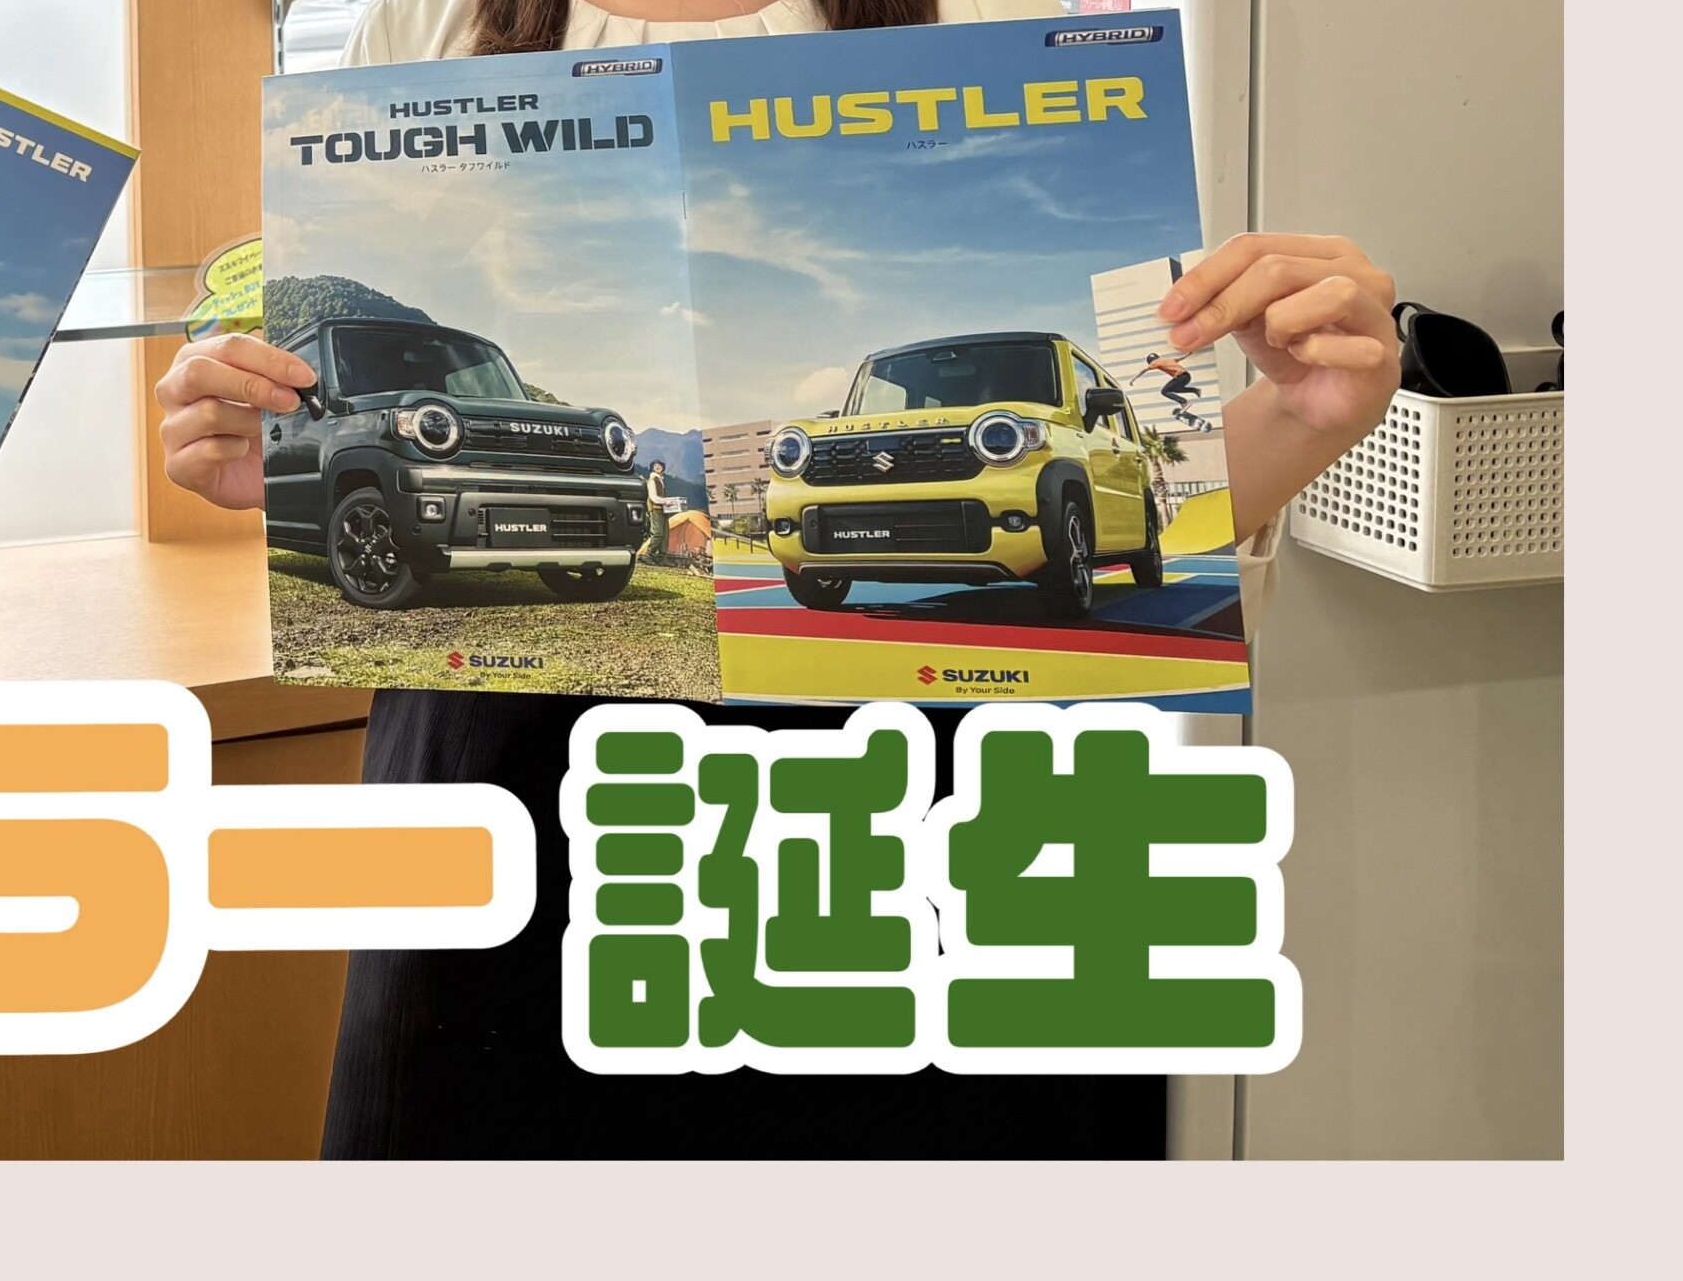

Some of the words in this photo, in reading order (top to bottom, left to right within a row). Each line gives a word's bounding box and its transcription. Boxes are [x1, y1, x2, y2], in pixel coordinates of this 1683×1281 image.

[1061, 28, 1148, 45] HYBRID
[587, 60, 653, 75] HYBRID
[389, 93, 539, 119] HUSTLER
[709, 76, 1149, 143] HUSTLER
[290, 123, 487, 166] TOUGH
[501, 114, 655, 155] WILD
[907, 139, 948, 150] ハスラー
[421, 163, 456, 173] ハスラー
[459, 160, 511, 172] タフワイルド
[509, 422, 570, 437] SUZUKI
[494, 522, 548, 534] HUSTLER
[833, 528, 891, 540] HUSTLER
[468, 654, 544, 669] SUZUKI
[479, 671, 491, 679] By
[493, 671, 511, 679] Your
[942, 668, 1030, 683] SUZUKI
[955, 686, 969, 695] By
[970, 686, 993, 694] Your
[993, 686, 1016, 694] Side
